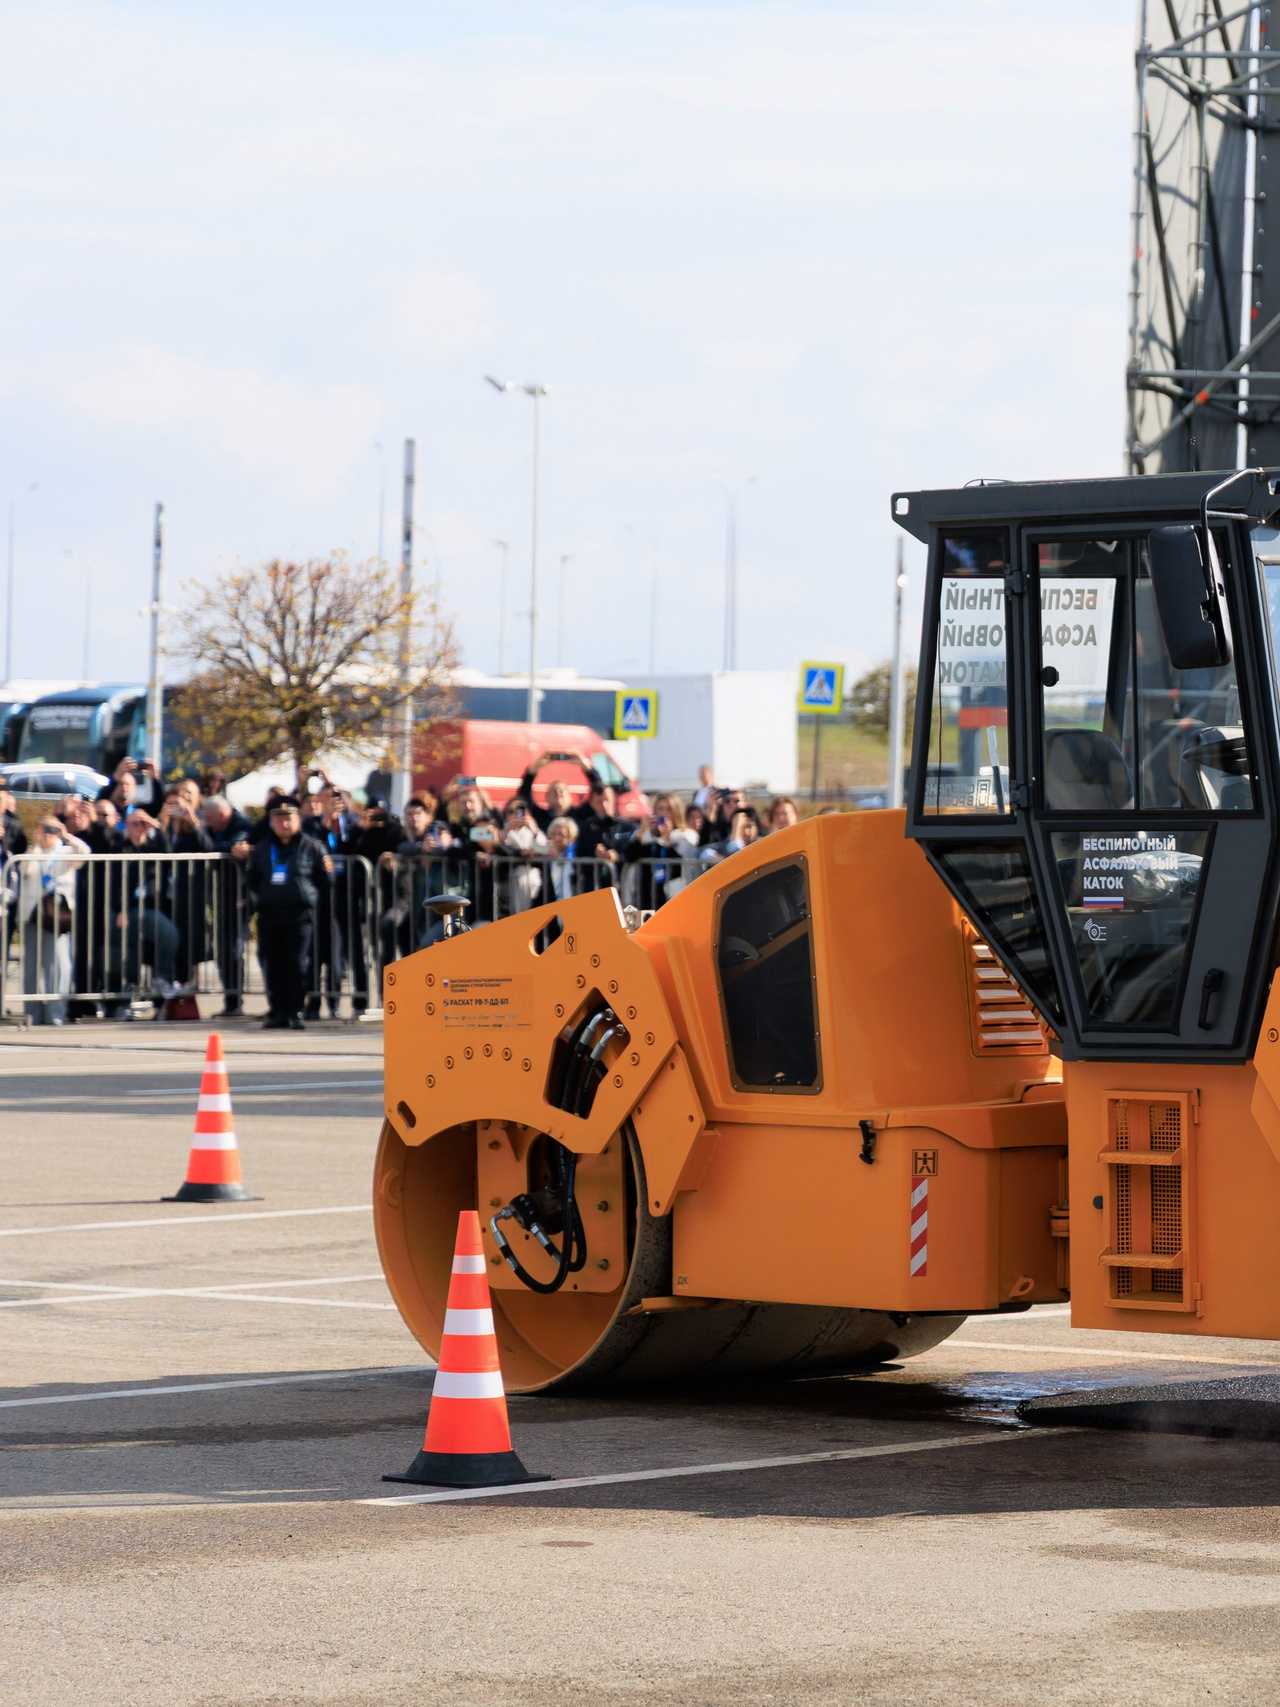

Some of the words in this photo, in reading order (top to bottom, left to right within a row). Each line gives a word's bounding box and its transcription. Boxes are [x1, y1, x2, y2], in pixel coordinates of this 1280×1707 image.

[1083, 834, 1176, 851] БЕСПИЛОТНЫЙ
[1083, 855, 1178, 870] АСФАЛЬТОВЫЙ
[1083, 877, 1124, 889] КАТОК
